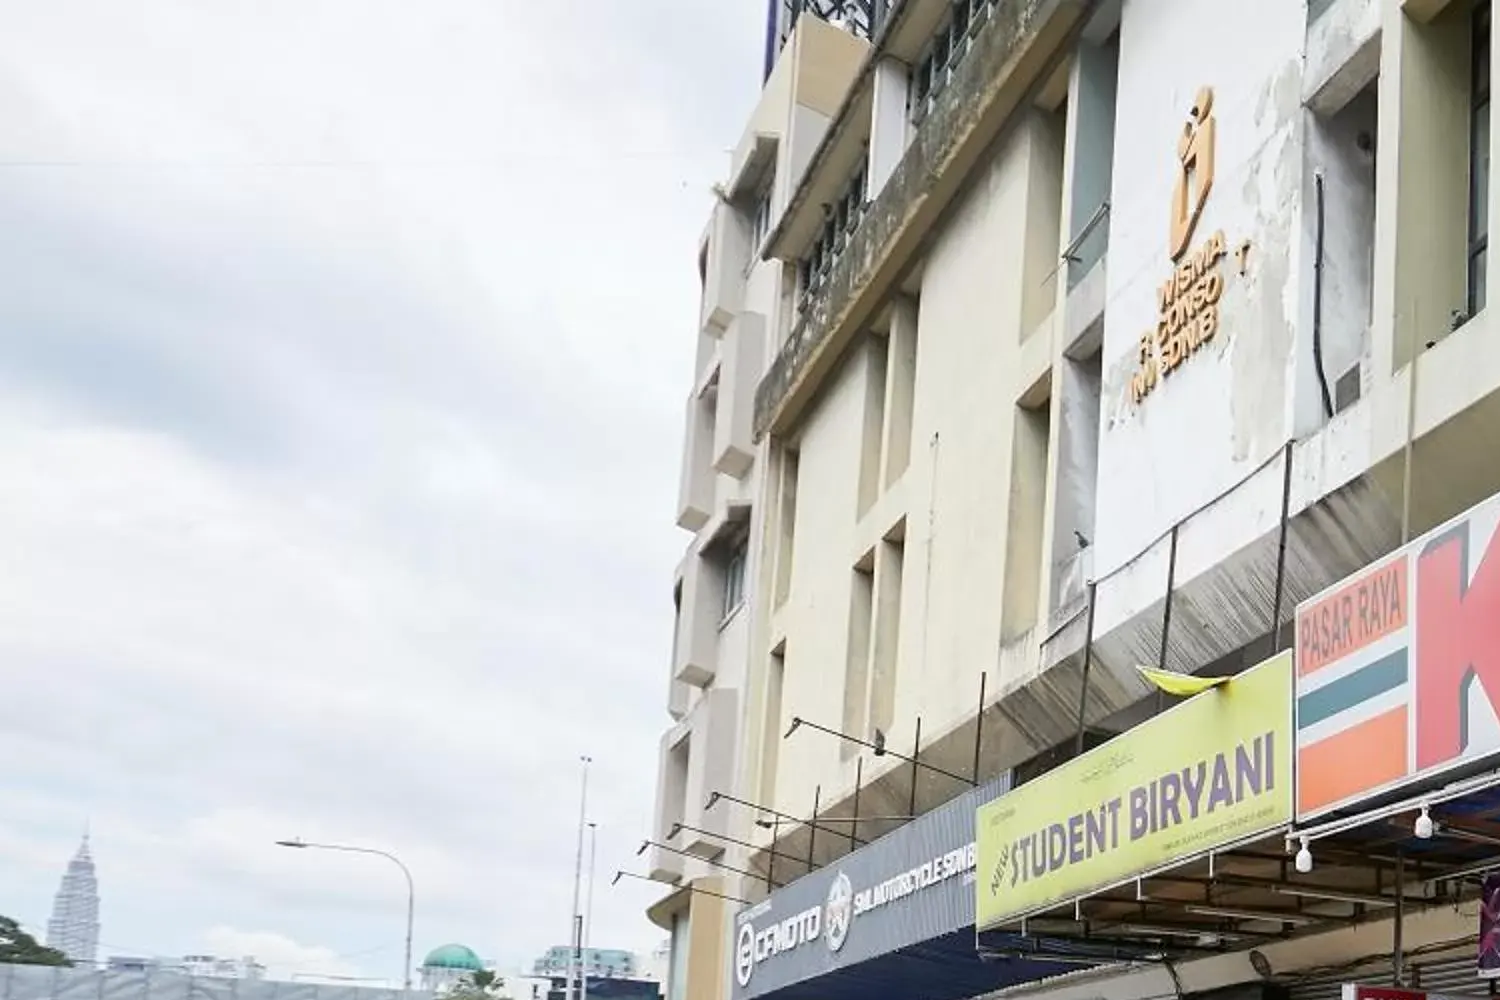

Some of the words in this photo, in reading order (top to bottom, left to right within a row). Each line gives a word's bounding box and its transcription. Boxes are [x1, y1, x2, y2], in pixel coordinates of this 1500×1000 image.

[1300, 595, 1353, 669] PASAR
[1357, 567, 1403, 641] RAYA
[1009, 796, 1122, 889] STUDENT
[1129, 730, 1275, 842] BIRYANI
[755, 905, 822, 962] CFMOTO
